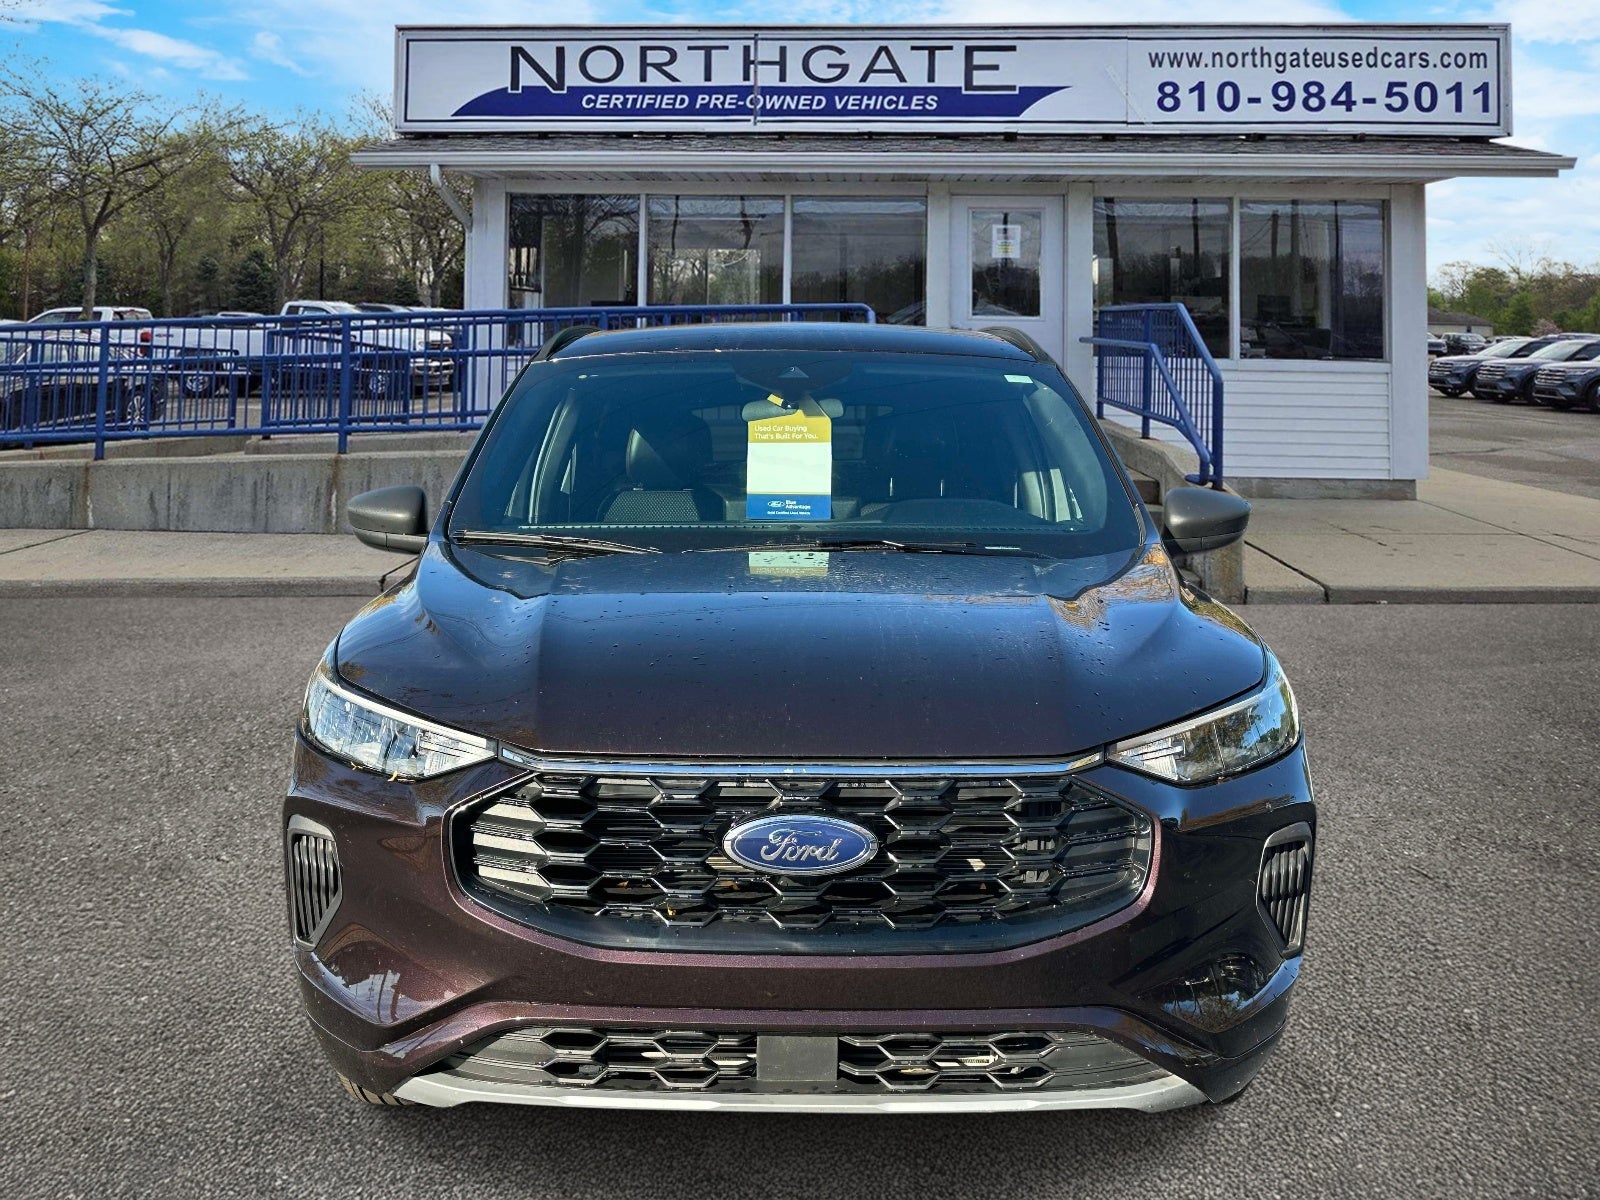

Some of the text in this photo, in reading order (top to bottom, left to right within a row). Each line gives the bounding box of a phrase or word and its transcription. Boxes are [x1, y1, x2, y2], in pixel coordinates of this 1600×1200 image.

[510, 45, 1017, 92] NORTHGATE
[1149, 46, 1488, 73] www.northgateusedcars.com
[581, 94, 938, 110] CERTIFIED PRE-OWNED VEHICLES
[1156, 80, 1491, 113] 810-984-5011
[760, 828, 843, 861] Ford
